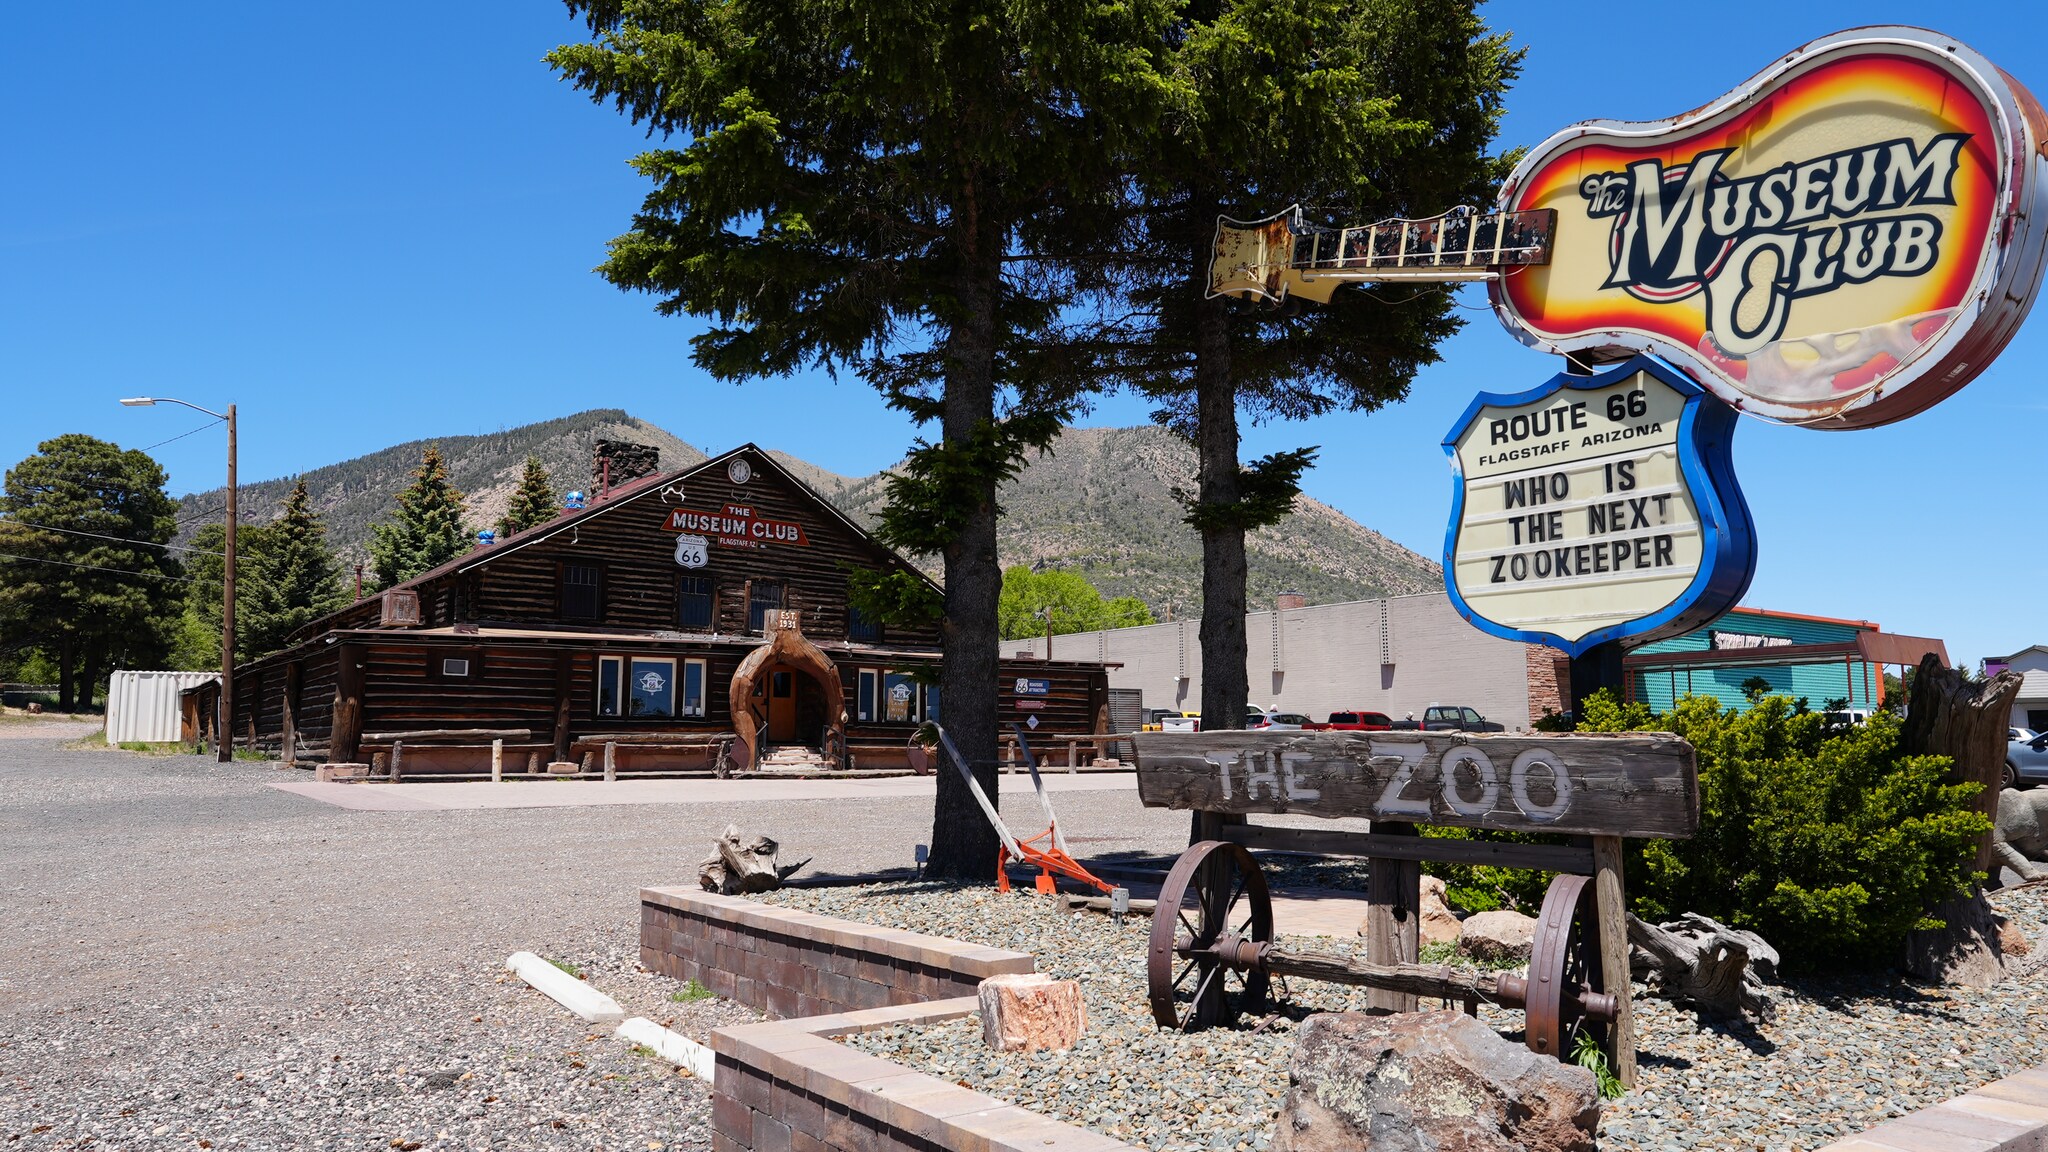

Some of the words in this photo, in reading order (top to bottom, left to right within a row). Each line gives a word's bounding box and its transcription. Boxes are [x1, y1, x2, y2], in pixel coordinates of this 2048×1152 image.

[1582, 170, 1628, 213] The
[1706, 216, 1939, 354] CLUB
[1489, 401, 1588, 446] ROUTE
[1606, 389, 1648, 422] 66
[1478, 440, 1571, 467] FLAGSTAFF
[1580, 422, 1663, 448] ARIZONA
[1504, 471, 1569, 510] WHO
[1604, 459, 1637, 494] IS
[672, 512, 747, 536] MUSEUM
[752, 521, 799, 541] CLUB
[728, 506, 750, 517] THE
[1508, 510, 1564, 546] THE
[1587, 493, 1672, 536] NEXT
[681, 549, 701, 564] 66
[1489, 534, 1675, 584] ZOOKEEPER
[779, 619, 797, 629] 1931
[780, 611, 798, 620] EST.
[1016, 682, 1027, 692] 66
[1203, 749, 1322, 801] THE
[1367, 739, 1574, 824] ZOO
